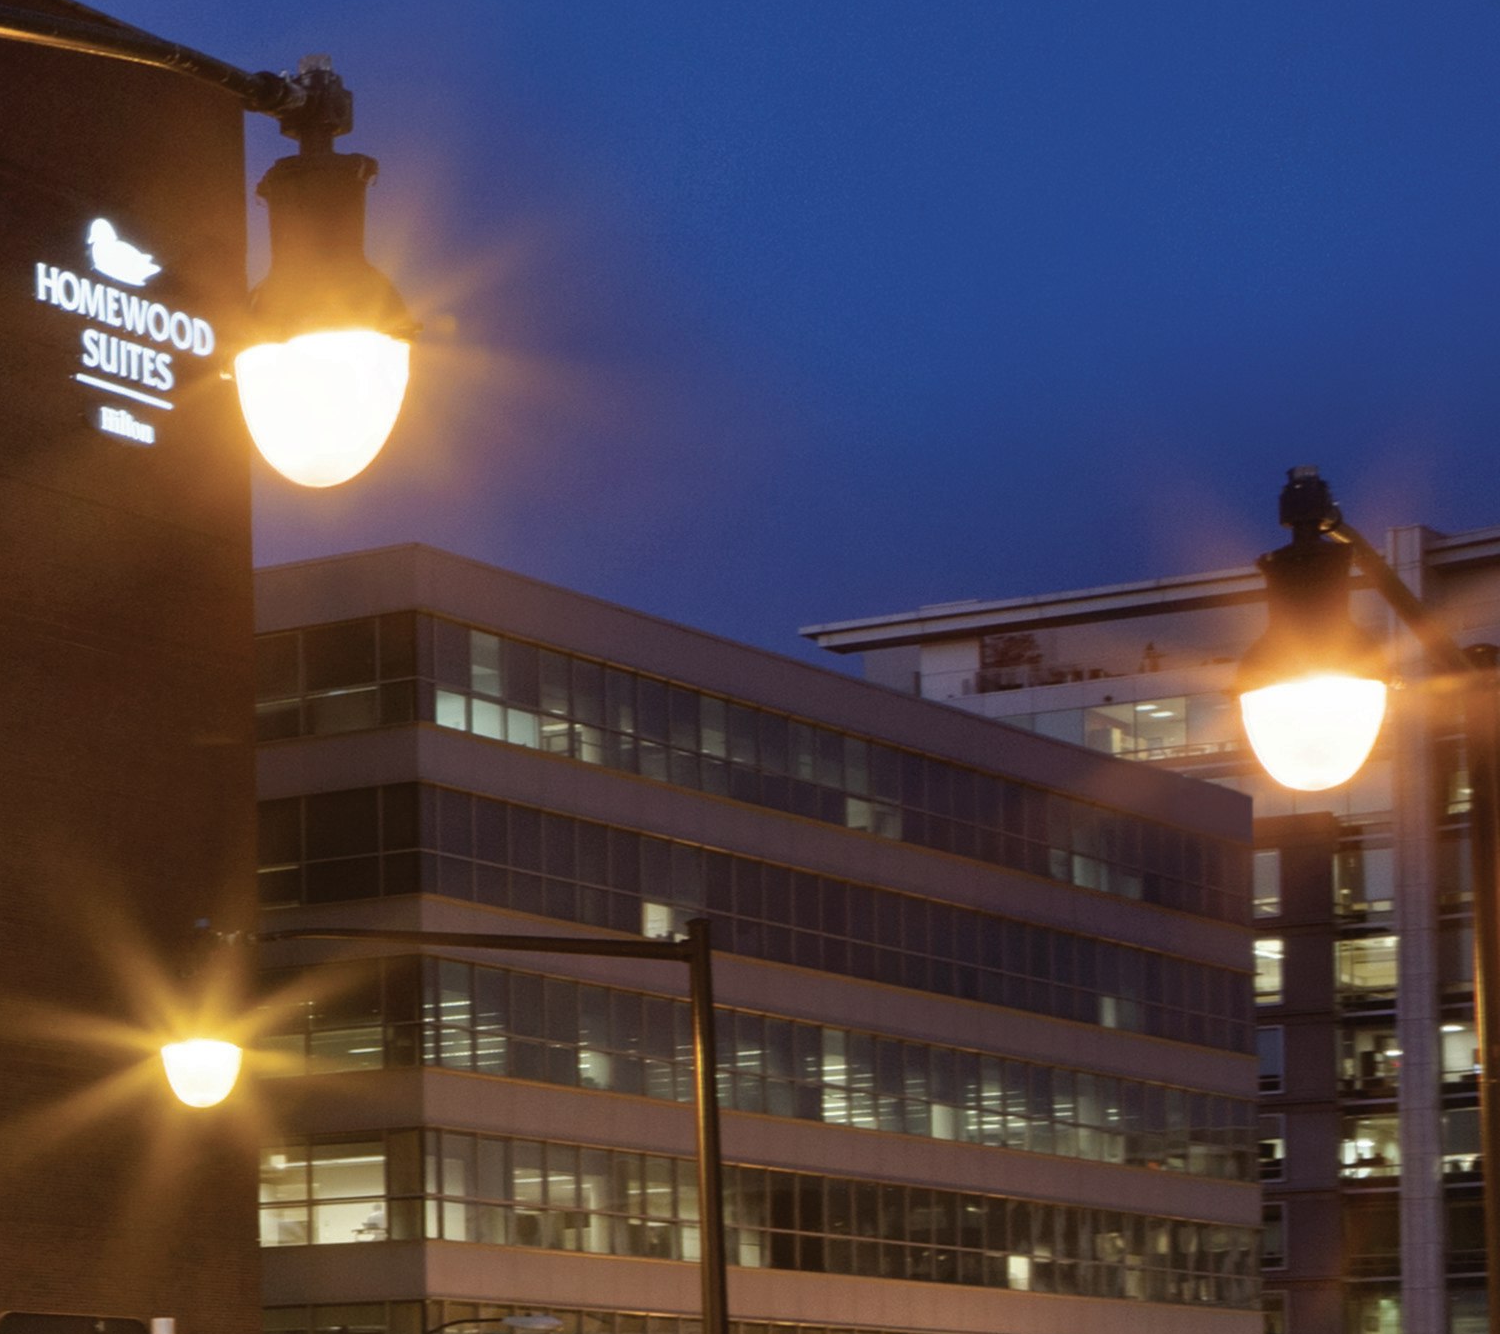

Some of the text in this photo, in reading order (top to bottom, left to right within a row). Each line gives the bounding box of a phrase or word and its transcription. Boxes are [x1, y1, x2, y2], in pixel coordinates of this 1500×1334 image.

[35, 262, 215, 357] HOMEWOOD
[81, 328, 175, 391] SUITES
[99, 405, 156, 445] Hilton
